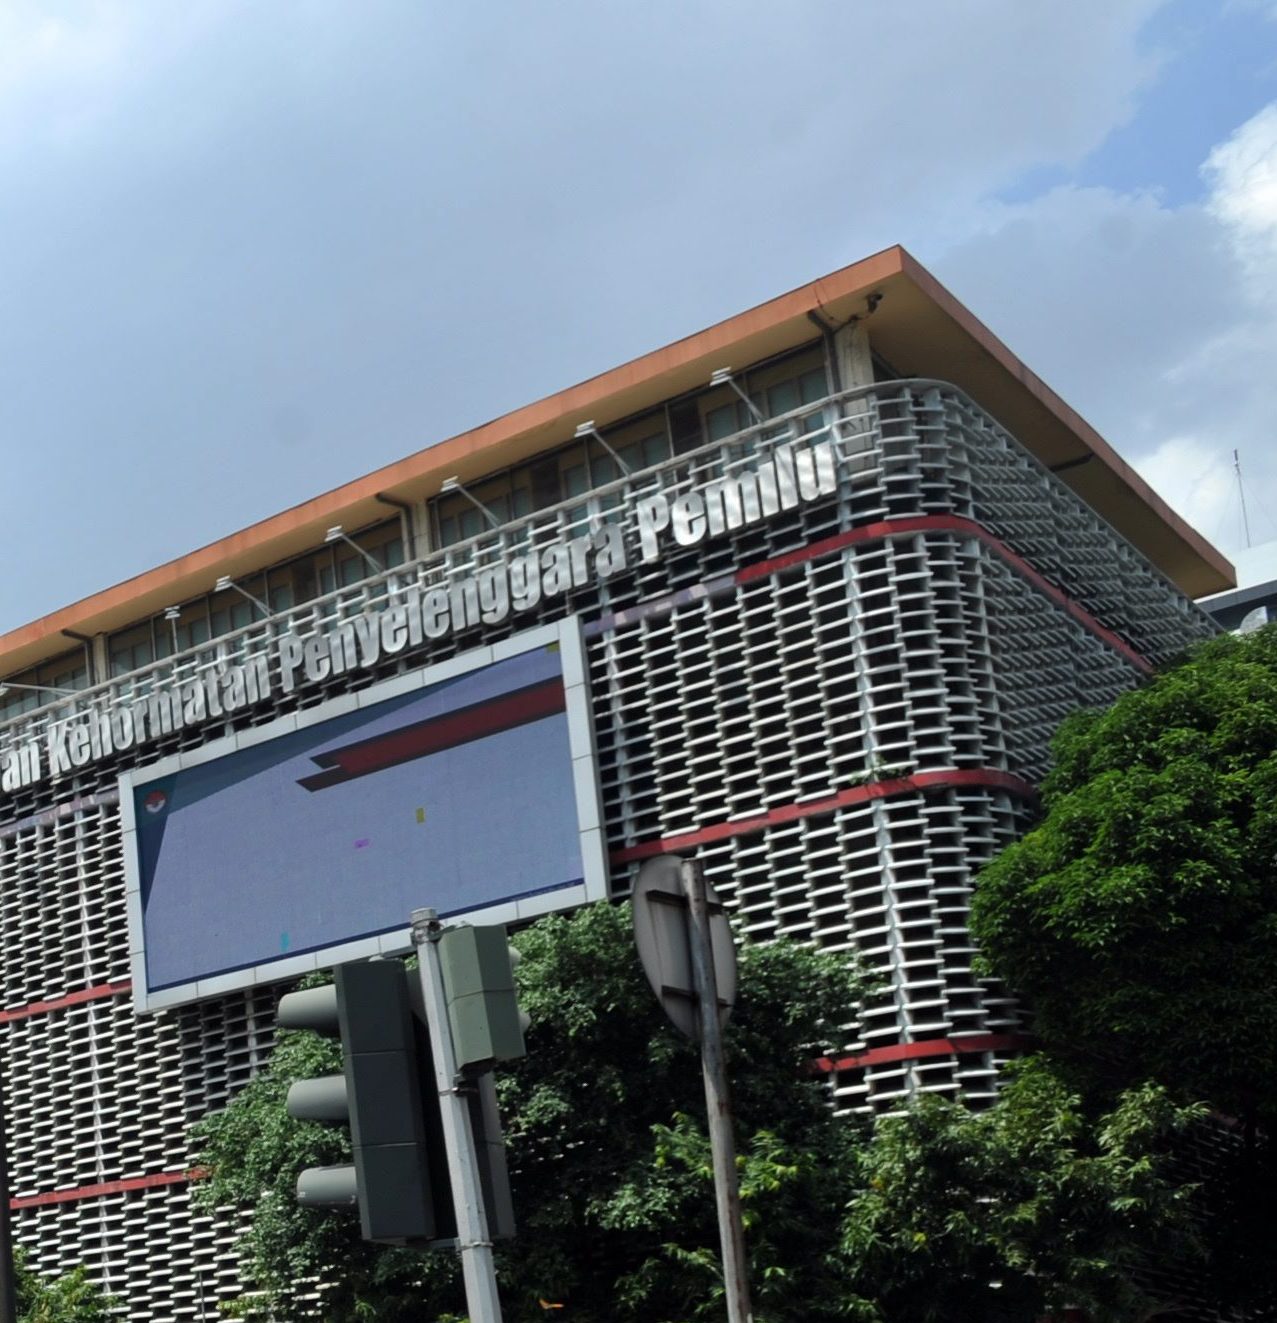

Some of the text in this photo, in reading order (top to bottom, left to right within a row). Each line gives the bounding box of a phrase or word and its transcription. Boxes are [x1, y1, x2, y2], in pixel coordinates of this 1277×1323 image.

[48, 654, 272, 776] Kehormatan
[279, 522, 627, 694] Penyelenggara
[637, 440, 838, 563] Pemilu
